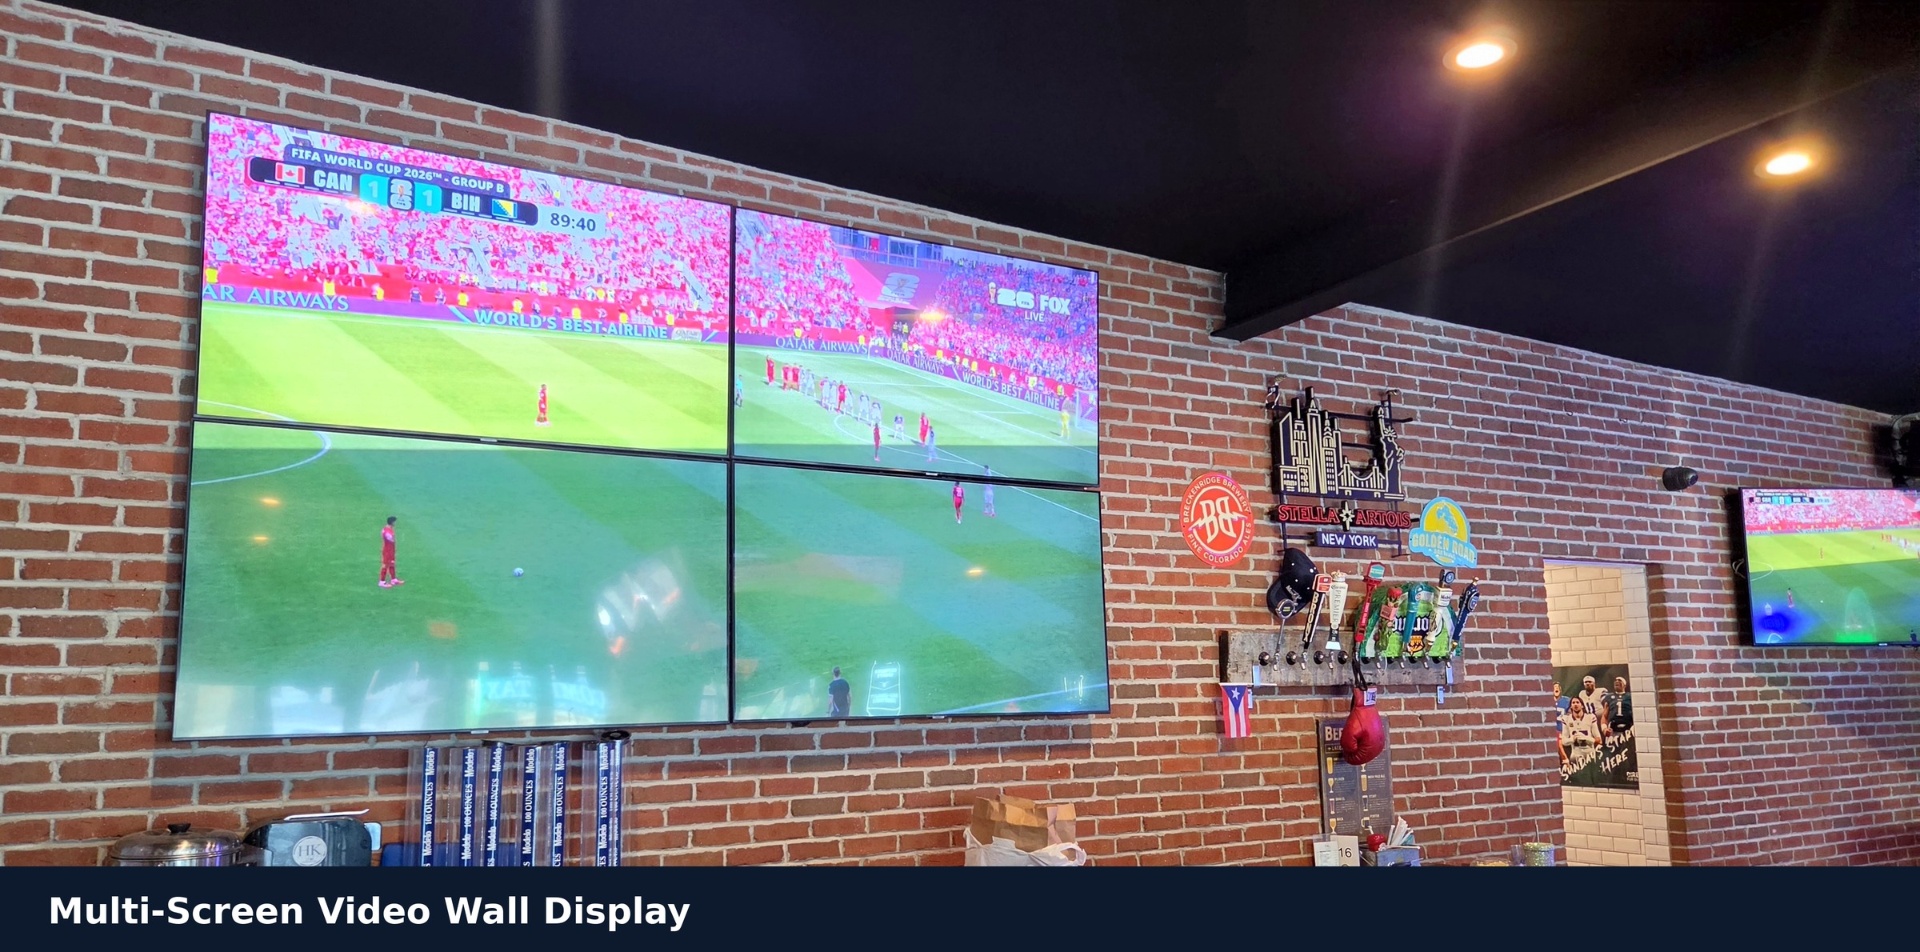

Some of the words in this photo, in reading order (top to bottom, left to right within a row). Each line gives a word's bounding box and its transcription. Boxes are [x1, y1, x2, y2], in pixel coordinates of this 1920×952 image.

[292, 148, 321, 163] FIFA
[324, 152, 372, 171] WORLD
[376, 162, 401, 176] CUP
[451, 175, 493, 192] GROUP
[496, 183, 504, 193] B
[314, 170, 352, 192] CAN
[368, 180, 378, 198] 1
[422, 189, 432, 206] 1
[451, 192, 480, 212] BIH
[550, 212, 596, 232] 89:40
[248, 288, 348, 310] AIRWAYS
[1040, 294, 1070, 316] FOX
[474, 310, 557, 330] WORLD'S
[562, 319, 602, 334] BEST
[608, 323, 668, 339] AIRLINE
[1024, 310, 1044, 322] LIVE
[776, 338, 815, 350] QATAR
[819, 340, 868, 354] AIRWAYS
[886, 349, 910, 365] QATAR
[913, 356, 944, 376] AIRWAYS
[962, 371, 999, 392] WORLD'S
[1001, 382, 1022, 398] BEST
[1024, 390, 1060, 410] AIRLINE
[1184, 476, 1221, 522] BRECKENRIDGE
[1222, 478, 1252, 512] BREWERY
[1278, 504, 1340, 524] STELLA
[1356, 510, 1412, 528] ARTOIS
[1188, 533, 1203, 553] FINE
[1203, 546, 1244, 564] COLORADO
[1243, 522, 1252, 546] ALES
[1322, 533, 1346, 546] NEW
[1348, 534, 1376, 547] YORK
[1412, 533, 1450, 551] GOLDEN
[1452, 540, 1475, 564] ROAD
[1303, 592, 1320, 642] BRONX
[425, 750, 435, 776] Modelo
[464, 752, 474, 777] Modelo
[492, 747, 502, 772] Modelo
[526, 748, 535, 774] Modelo
[556, 747, 565, 770] Modelo
[600, 746, 608, 770] Modelo
[1560, 744, 1604, 781] SUNDAYS
[1600, 748, 1629, 774] HERE
[425, 782, 434, 812] OUNCES
[464, 784, 472, 816] OUNCES
[490, 778, 499, 809] OUNCES
[525, 780, 534, 812] OUNCES
[556, 776, 564, 806] OUNCES
[600, 776, 608, 807] OUNCES
[424, 812, 432, 825] 100
[464, 816, 472, 828] 100
[490, 809, 498, 820] 100
[524, 812, 532, 823] 100
[600, 807, 608, 818] 100
[424, 830, 432, 856] Modelo
[462, 833, 472, 860] Modelo
[487, 826, 496, 851] Modelo
[522, 828, 532, 854] Modelo
[554, 822, 562, 846] Modelo
[298, 844, 321, 856] HK
[1338, 848, 1352, 858] 16
